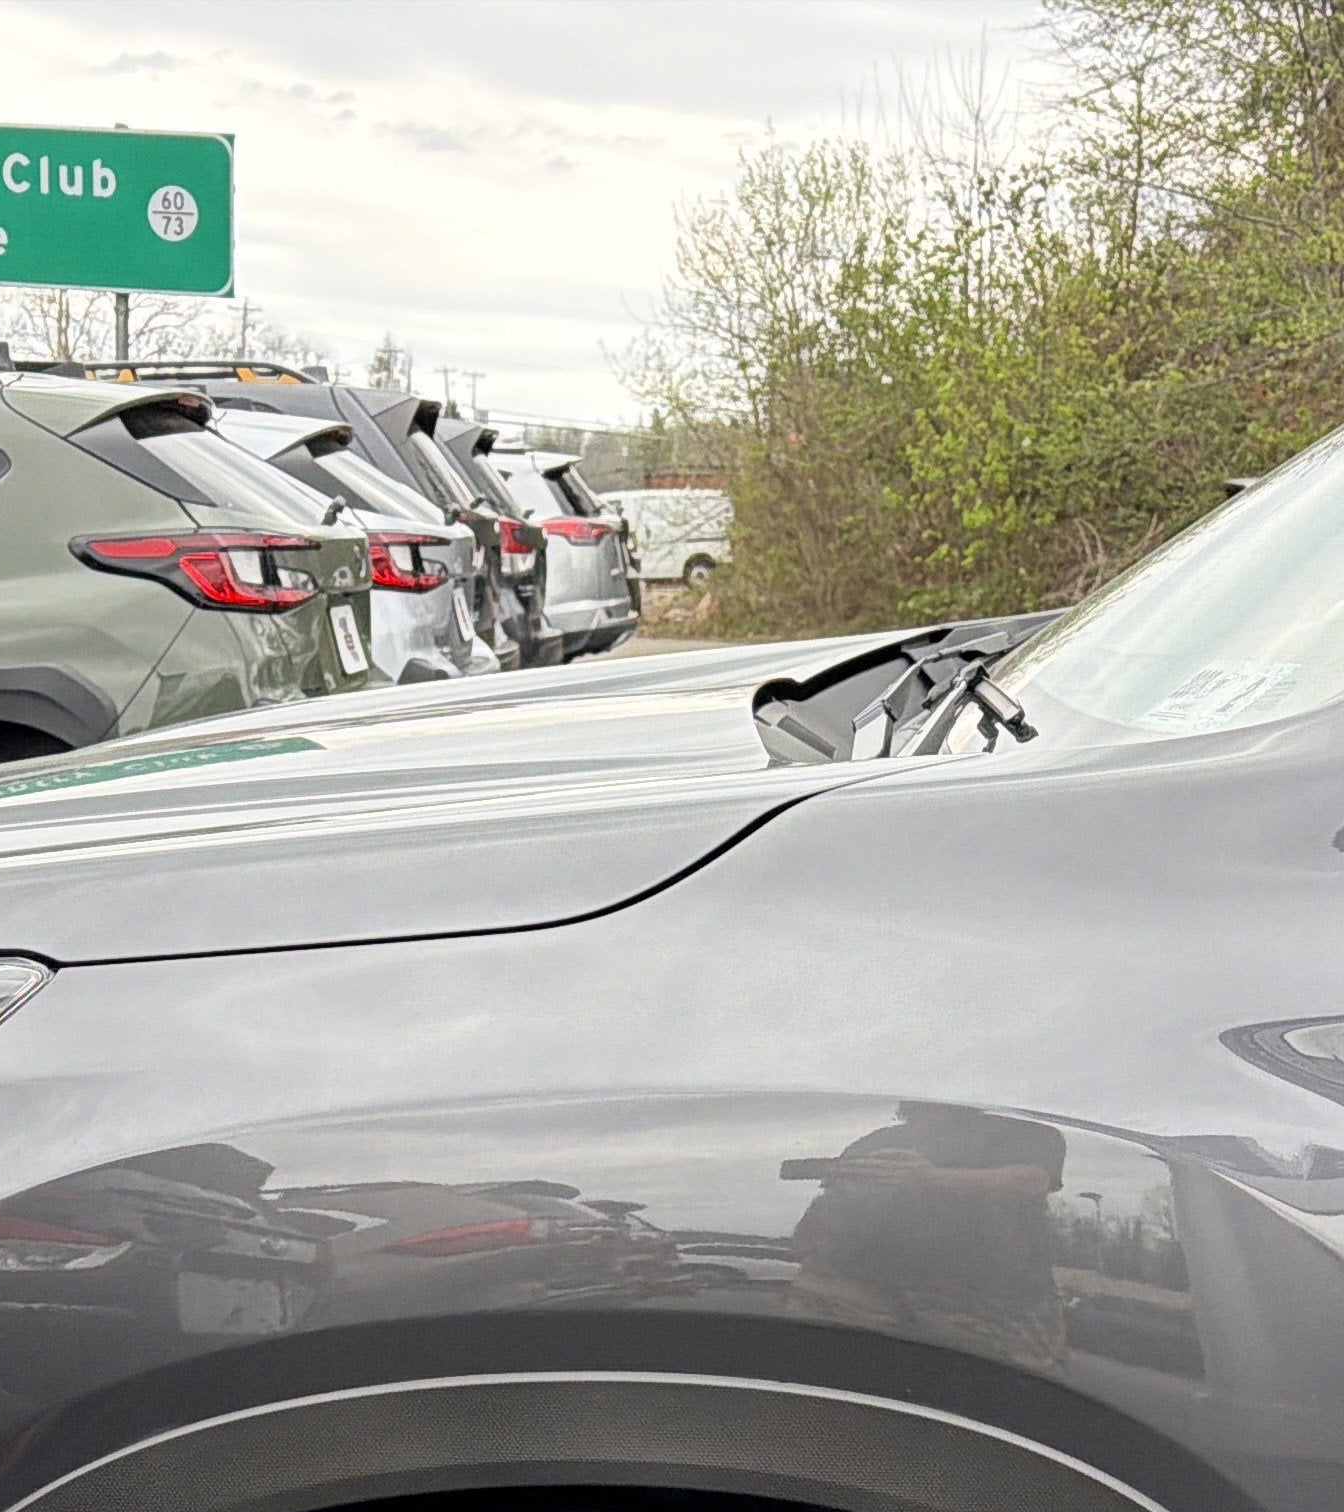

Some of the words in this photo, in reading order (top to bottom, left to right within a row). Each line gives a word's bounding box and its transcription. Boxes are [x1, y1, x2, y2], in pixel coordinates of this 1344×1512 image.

[2, 152, 116, 198] Club
[161, 191, 185, 210] 60
[162, 215, 185, 236] 73
